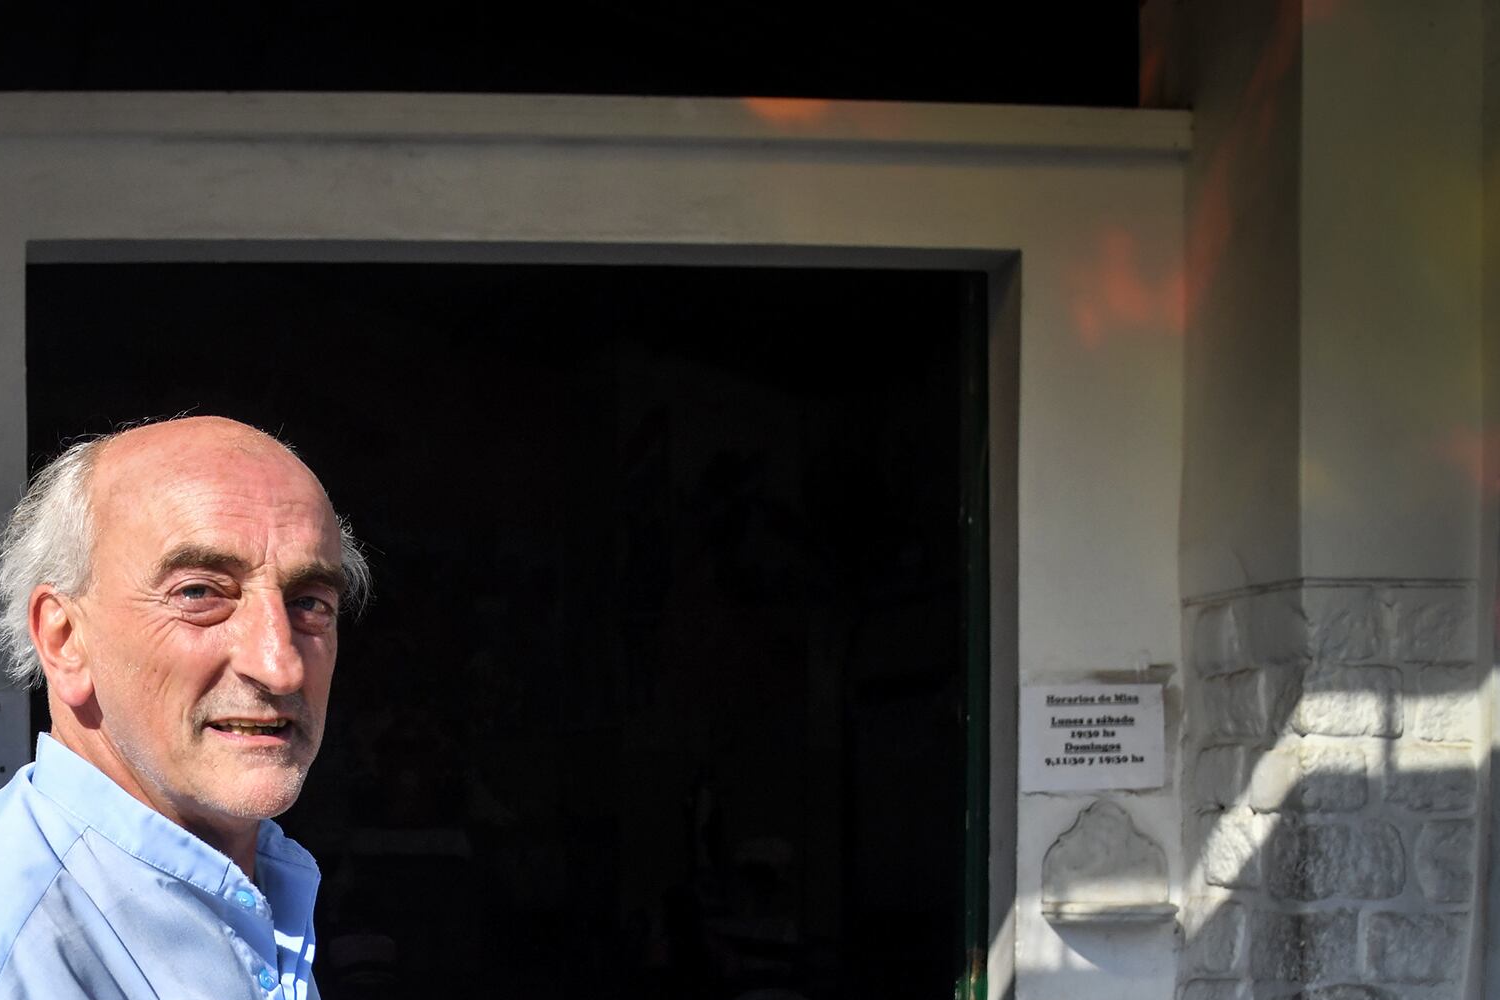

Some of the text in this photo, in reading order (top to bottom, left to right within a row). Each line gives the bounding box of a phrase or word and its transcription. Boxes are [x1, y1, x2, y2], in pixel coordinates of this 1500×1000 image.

[1046, 693, 1139, 705] Horarios de Misa
[1051, 716, 1084, 726] Lunes
[1070, 728, 1116, 739] 19:30 hs
[1064, 742, 1121, 753] Domingos
[1099, 755, 1129, 765] 19:30
[1131, 753, 1145, 763] hs
